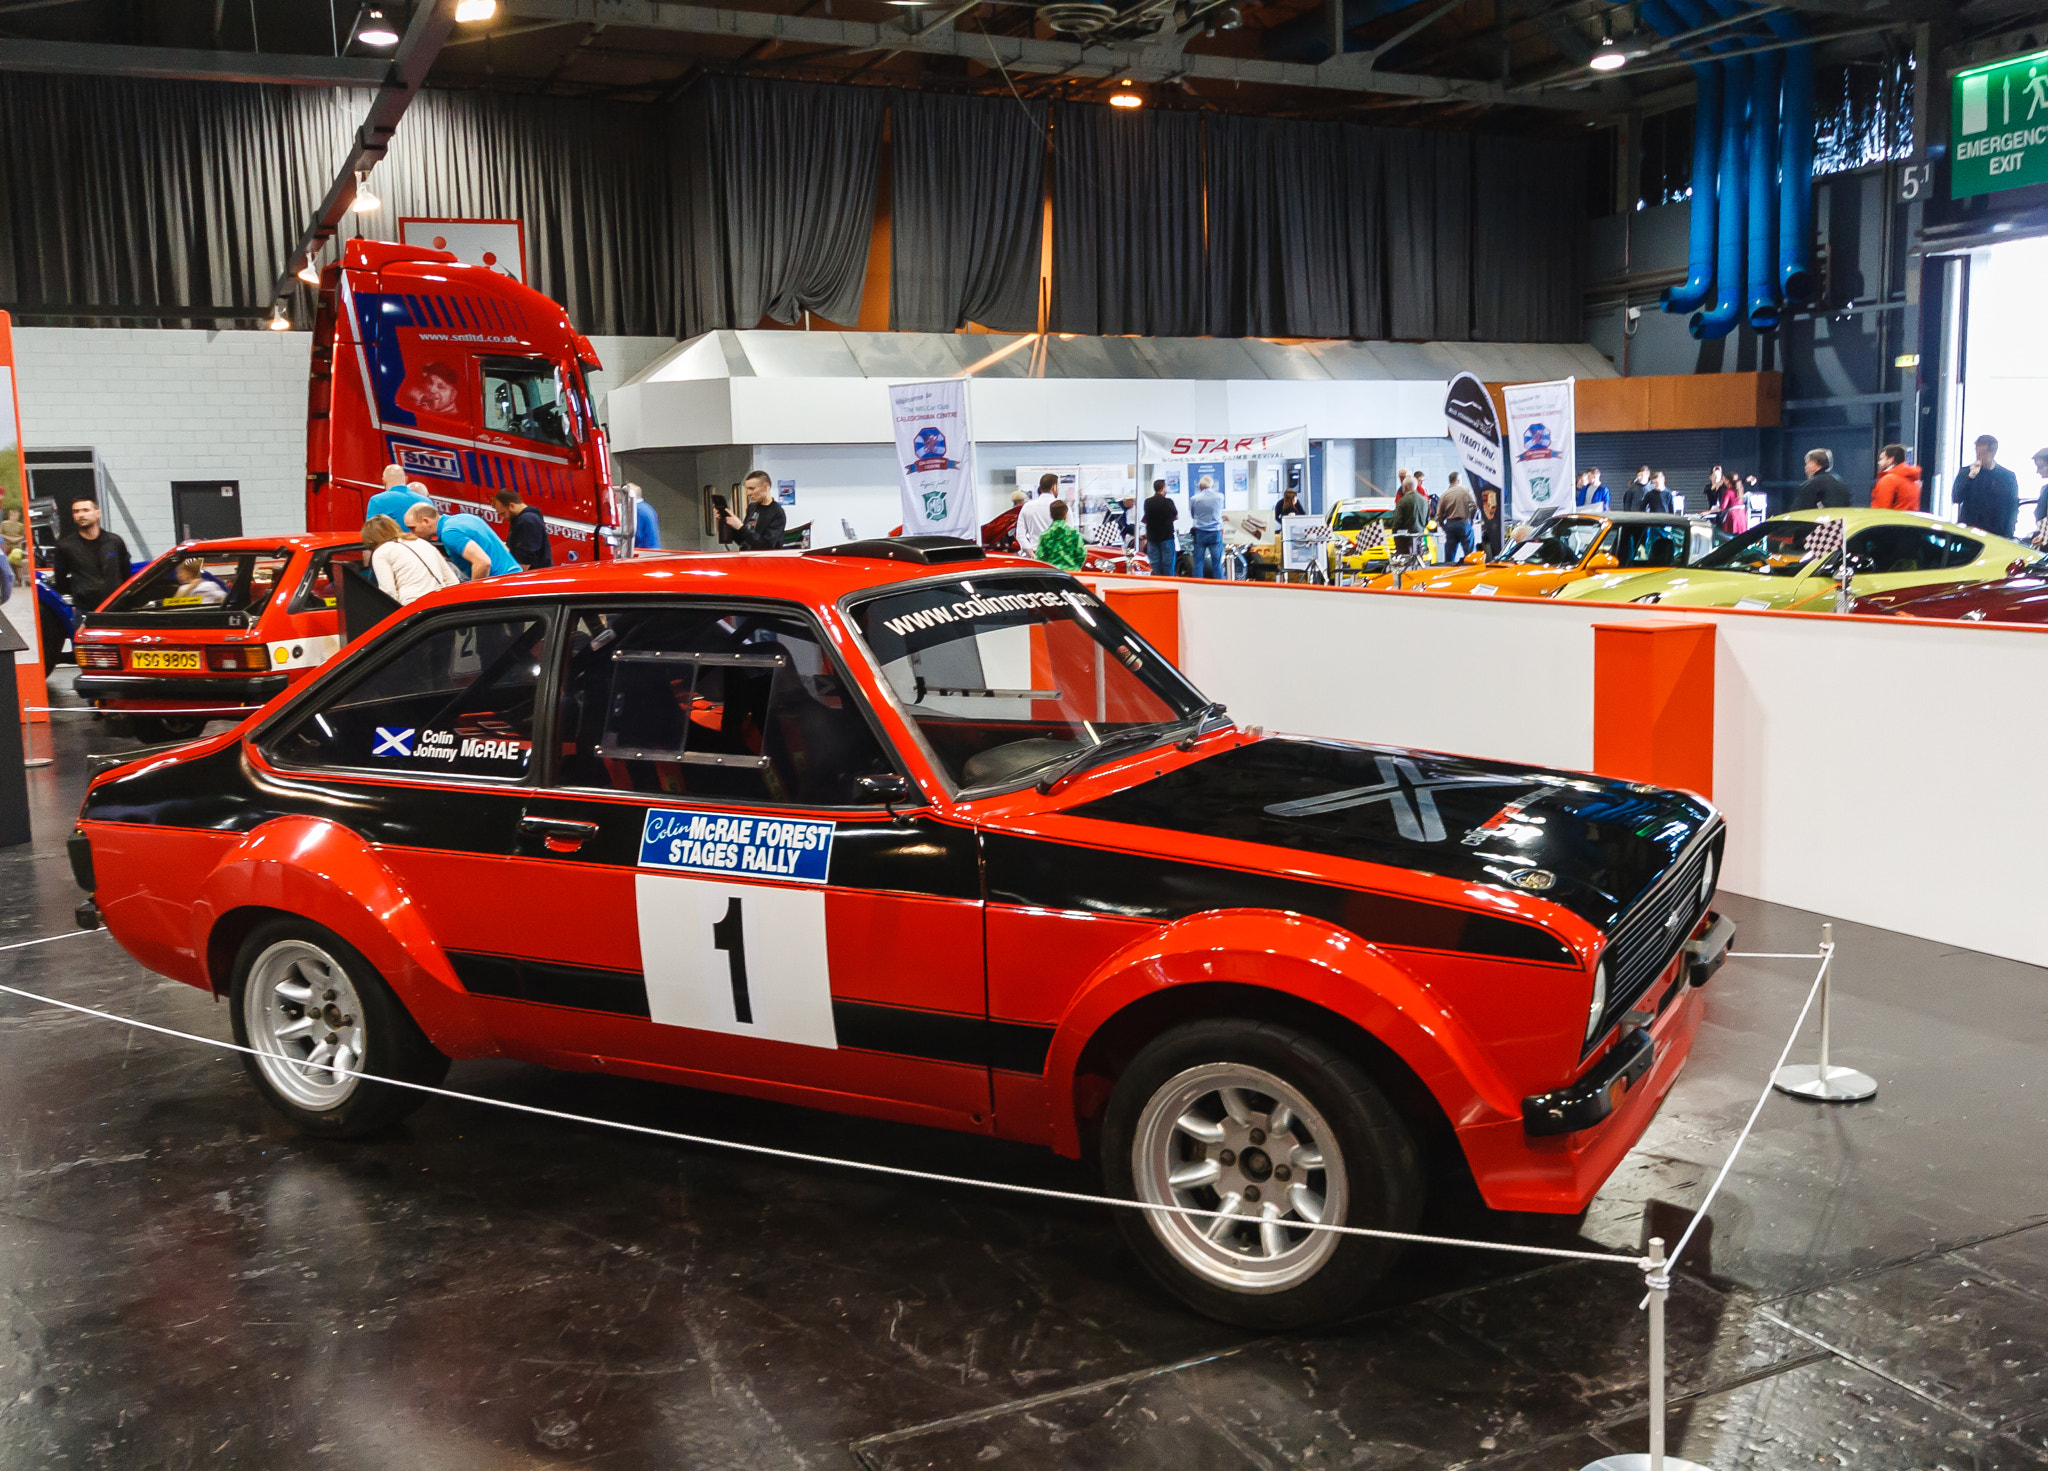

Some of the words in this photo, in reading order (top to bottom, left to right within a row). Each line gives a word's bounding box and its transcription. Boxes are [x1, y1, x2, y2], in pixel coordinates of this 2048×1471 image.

[1956, 125, 2048, 160] EMERGENC
[1989, 151, 2025, 176] EXIT
[1171, 434, 1275, 454] START
[135, 652, 160, 668] YSG
[163, 652, 198, 668] 980S
[422, 729, 454, 745] Colin
[413, 744, 458, 762] Johnny
[460, 739, 521, 760] McRAE
[645, 816, 691, 844] Colin
[689, 816, 754, 844] McRAE
[755, 822, 832, 851] FOREST
[669, 839, 738, 868] STAGES
[742, 846, 801, 874] RALLY
[712, 896, 754, 1024] 1
